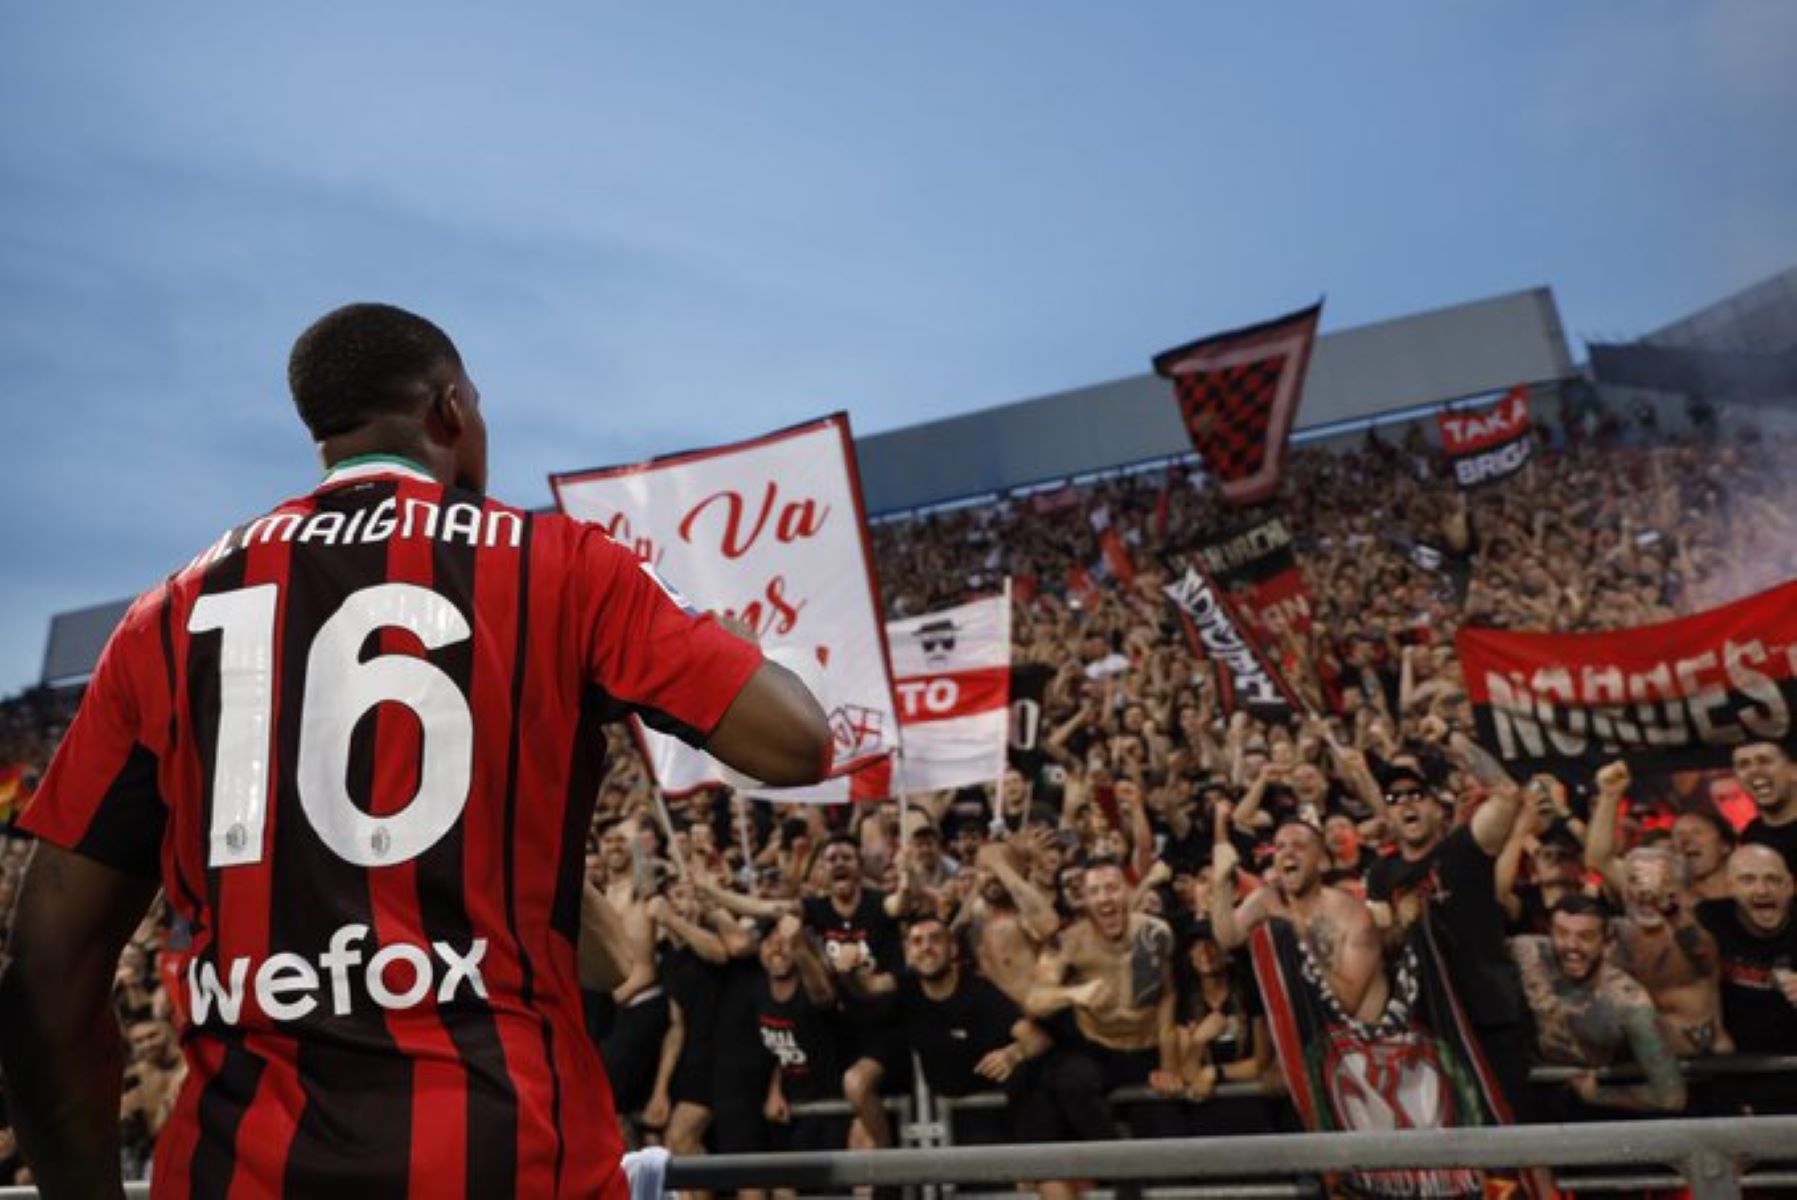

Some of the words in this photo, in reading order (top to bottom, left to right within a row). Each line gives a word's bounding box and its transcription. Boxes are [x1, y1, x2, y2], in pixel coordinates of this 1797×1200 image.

[678, 480, 830, 559] Va
[187, 583, 473, 866] 16
[188, 923, 488, 1026] wefox
